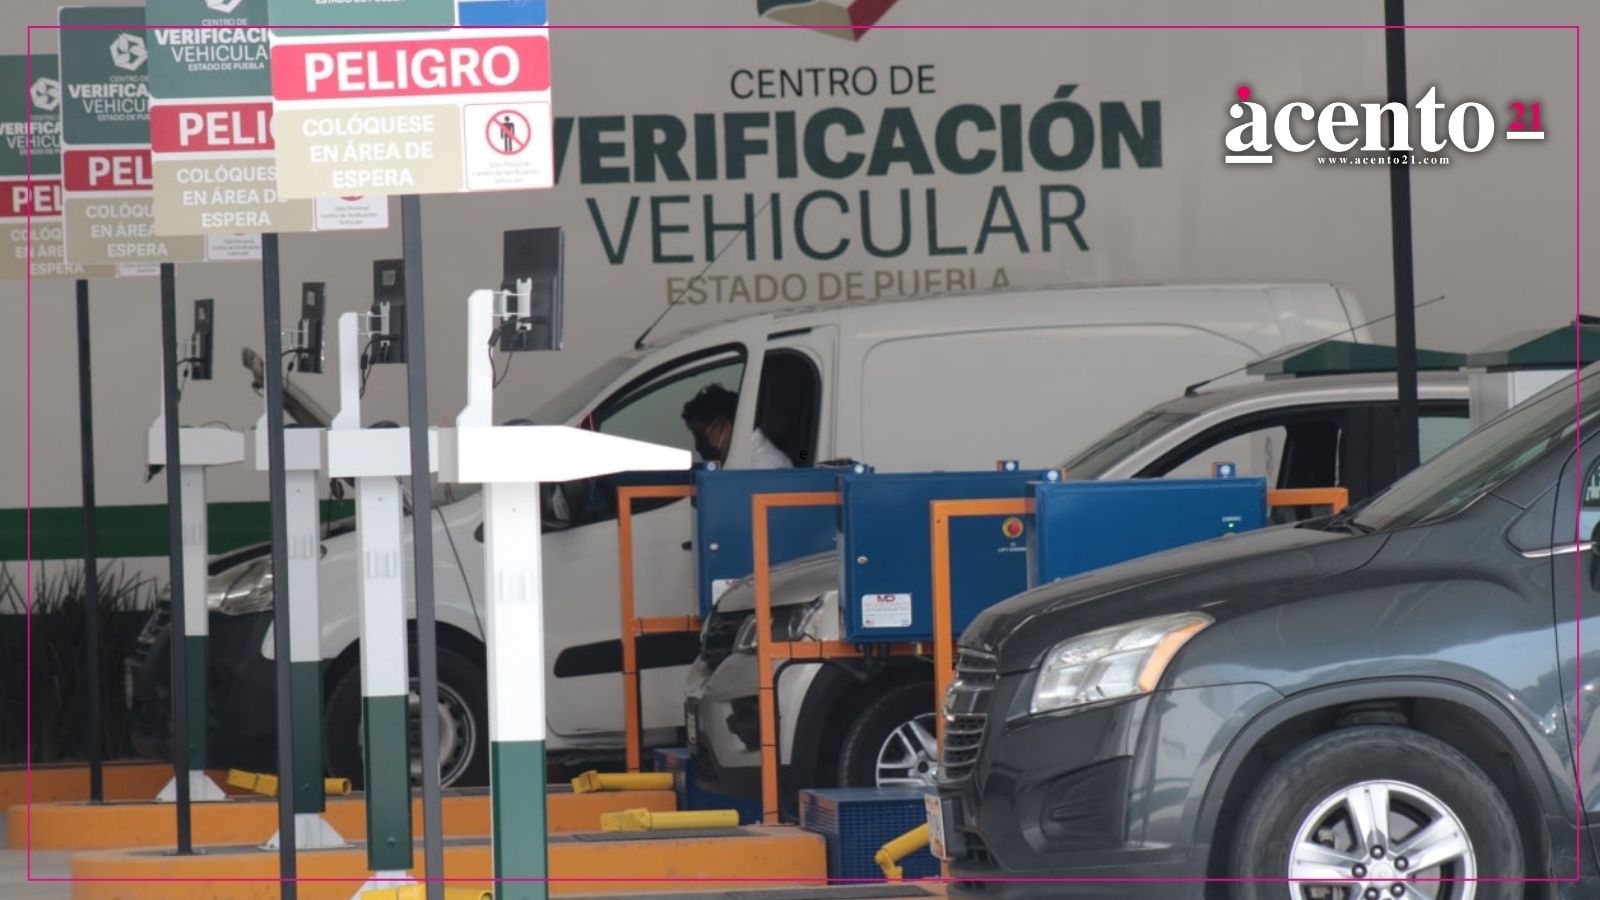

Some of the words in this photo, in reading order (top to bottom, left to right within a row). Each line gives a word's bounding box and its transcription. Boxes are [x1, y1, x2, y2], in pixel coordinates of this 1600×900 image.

[154, 27, 270, 45] VERIFICACI
[171, 44, 269, 63] VEHICULA
[304, 45, 520, 93] PELIGRO
[68, 83, 149, 98] VERIFICA
[730, 66, 877, 99] CENTRO
[890, 64, 936, 95] DE
[82, 98, 149, 113] VEHICU
[0, 121, 62, 136] ERIFICA
[179, 110, 275, 146] PELI
[303, 113, 435, 137] COLÓQUESE
[6, 134, 61, 149] VEHICU
[310, 145, 338, 162] EN
[342, 141, 399, 161] ÁREA
[405, 141, 433, 159] DE
[88, 156, 153, 186] PEL
[176, 163, 278, 183] COLÓQUES
[332, 169, 414, 189] ESPERA
[12, 185, 62, 213] PEL
[182, 190, 208, 206] EN
[211, 186, 260, 204] ÁREA
[263, 188, 288, 203] D
[86, 201, 154, 218] COLÓQU
[202, 211, 271, 227] ESPERA
[91, 224, 112, 238] EN
[585, 183, 1090, 265] VEHICULAR
[10, 226, 62, 242] COLÓQ
[38, 242, 64, 257] ÁRE
[107, 242, 168, 257] ESPERA
[31, 262, 84, 275] ESPERA
[666, 273, 806, 304] ESTADO
[818, 271, 863, 300] DE
